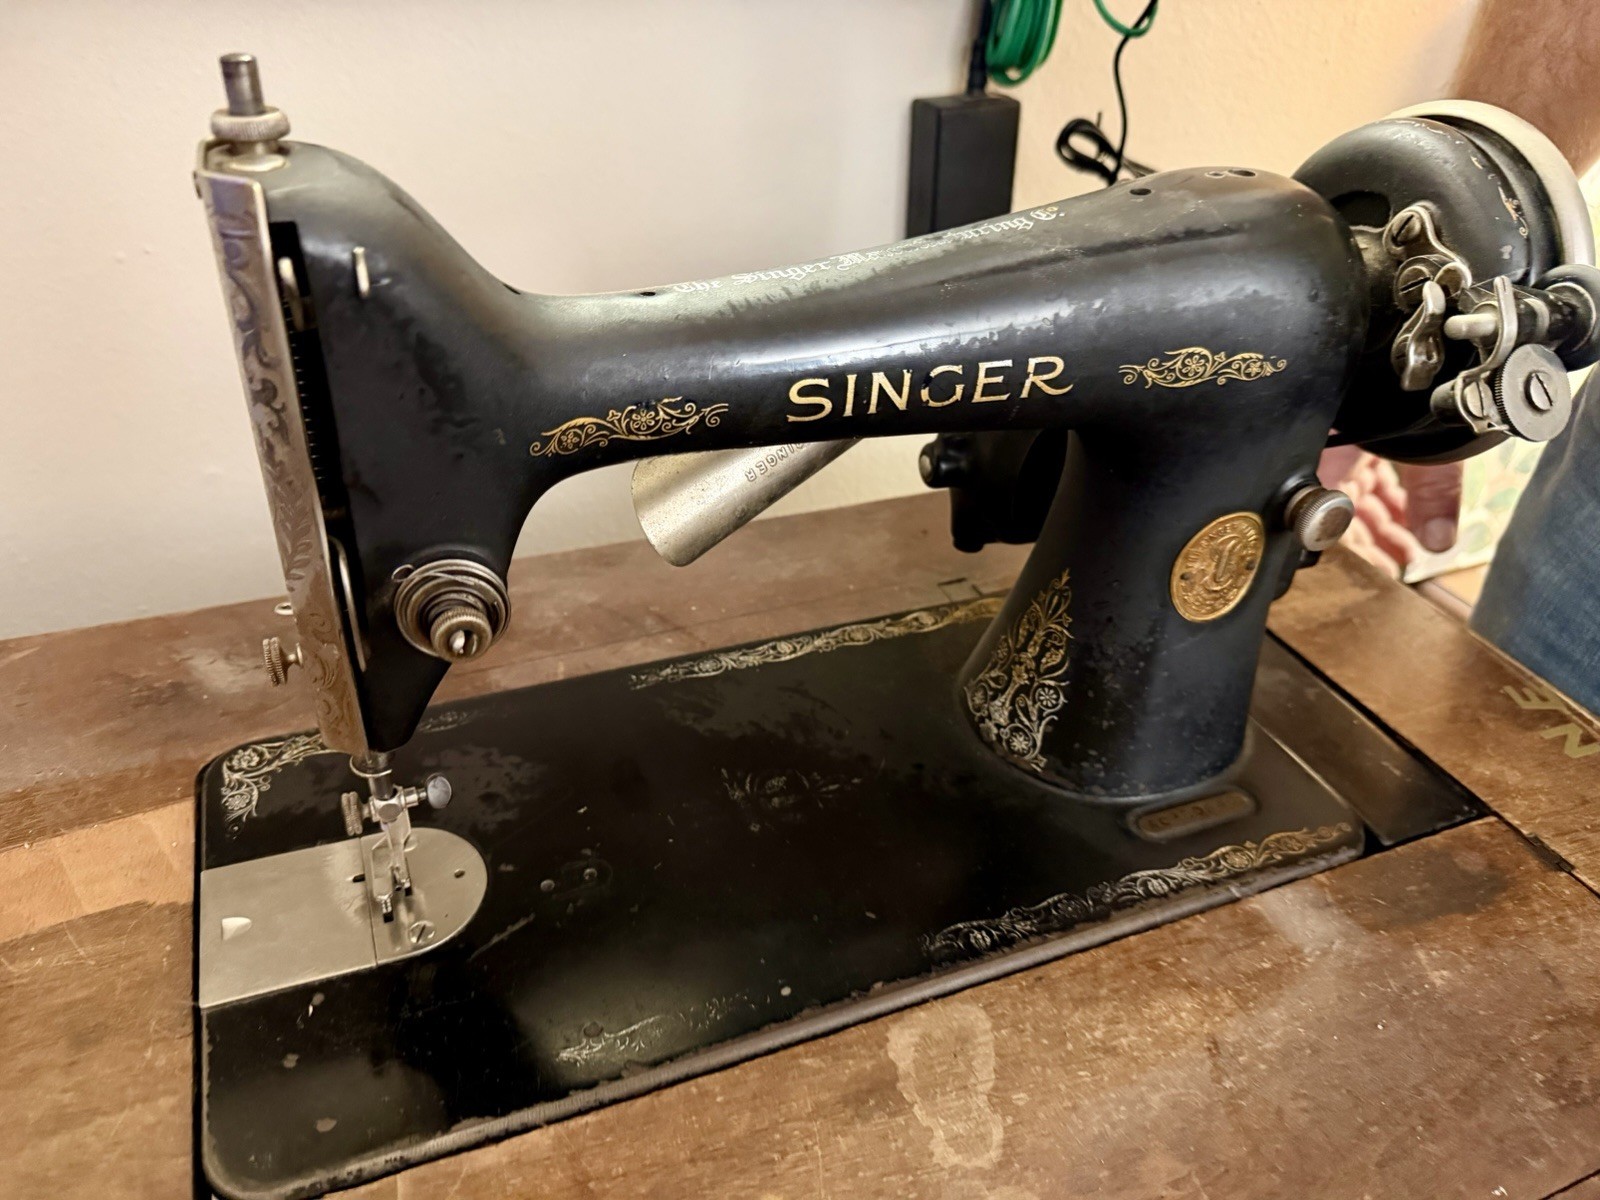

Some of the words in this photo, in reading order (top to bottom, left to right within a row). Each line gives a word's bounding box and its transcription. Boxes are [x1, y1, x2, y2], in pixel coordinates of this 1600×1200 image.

[673, 279, 723, 293] The
[731, 259, 831, 285] Singer
[786, 356, 1074, 422] SINGER
